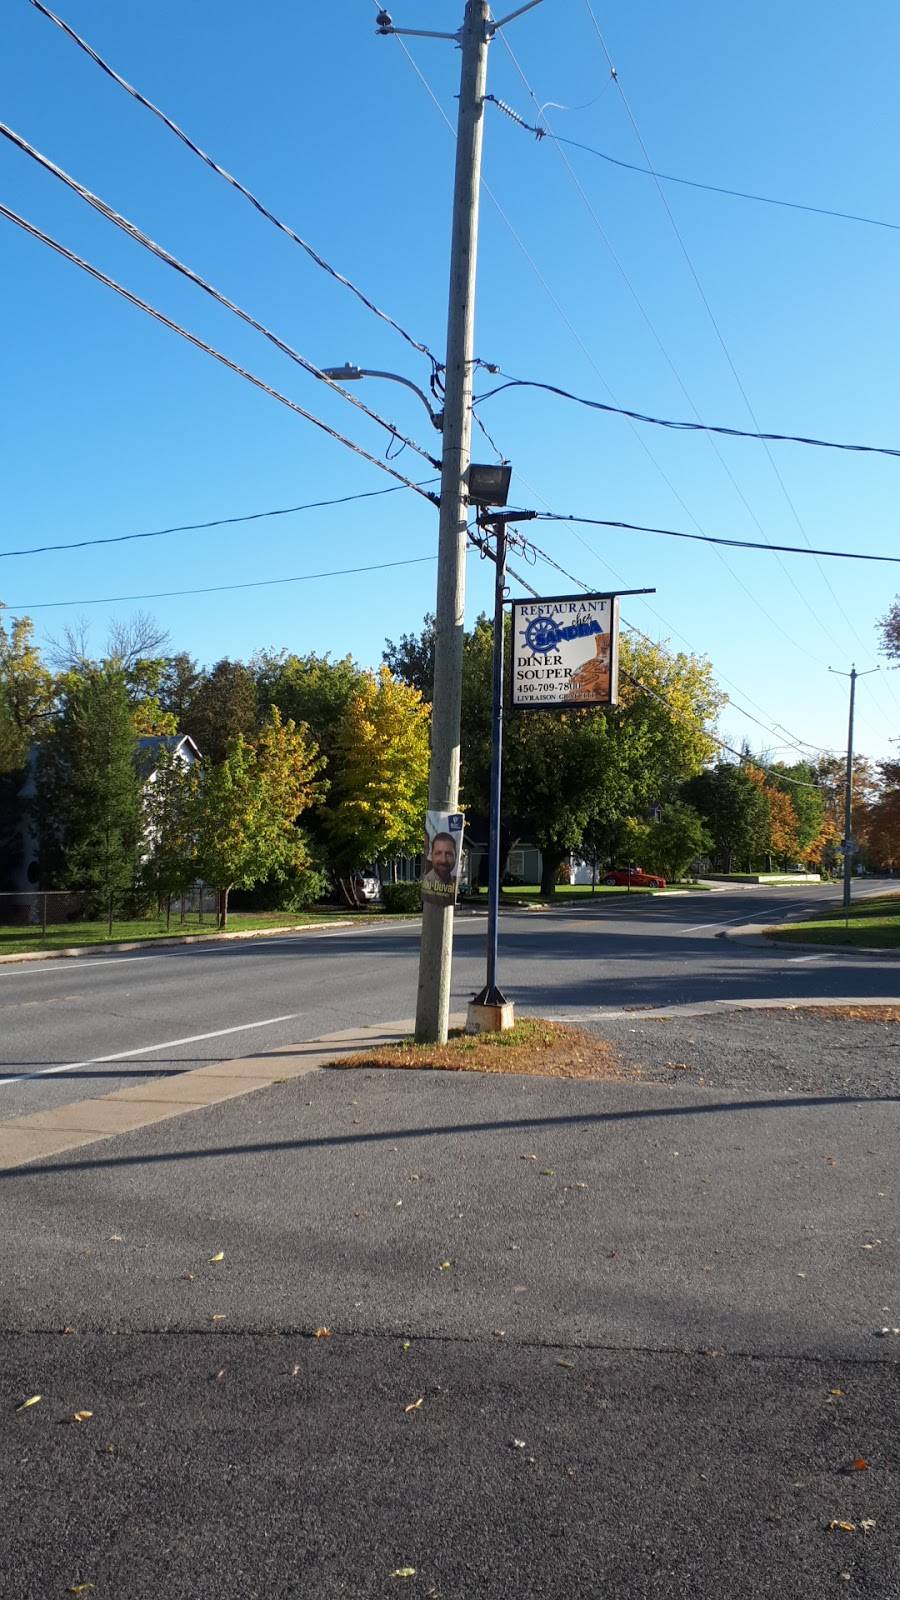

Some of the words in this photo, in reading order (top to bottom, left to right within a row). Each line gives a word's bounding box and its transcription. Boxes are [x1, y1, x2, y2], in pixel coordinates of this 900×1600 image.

[521, 601, 607, 616] RESTAURANT
[572, 613, 593, 627] chez
[535, 620, 603, 646] SANDRA
[518, 655, 563, 667] DINER
[517, 668, 573, 680] SOUPER
[517, 694, 556, 702] LIVRAISON
